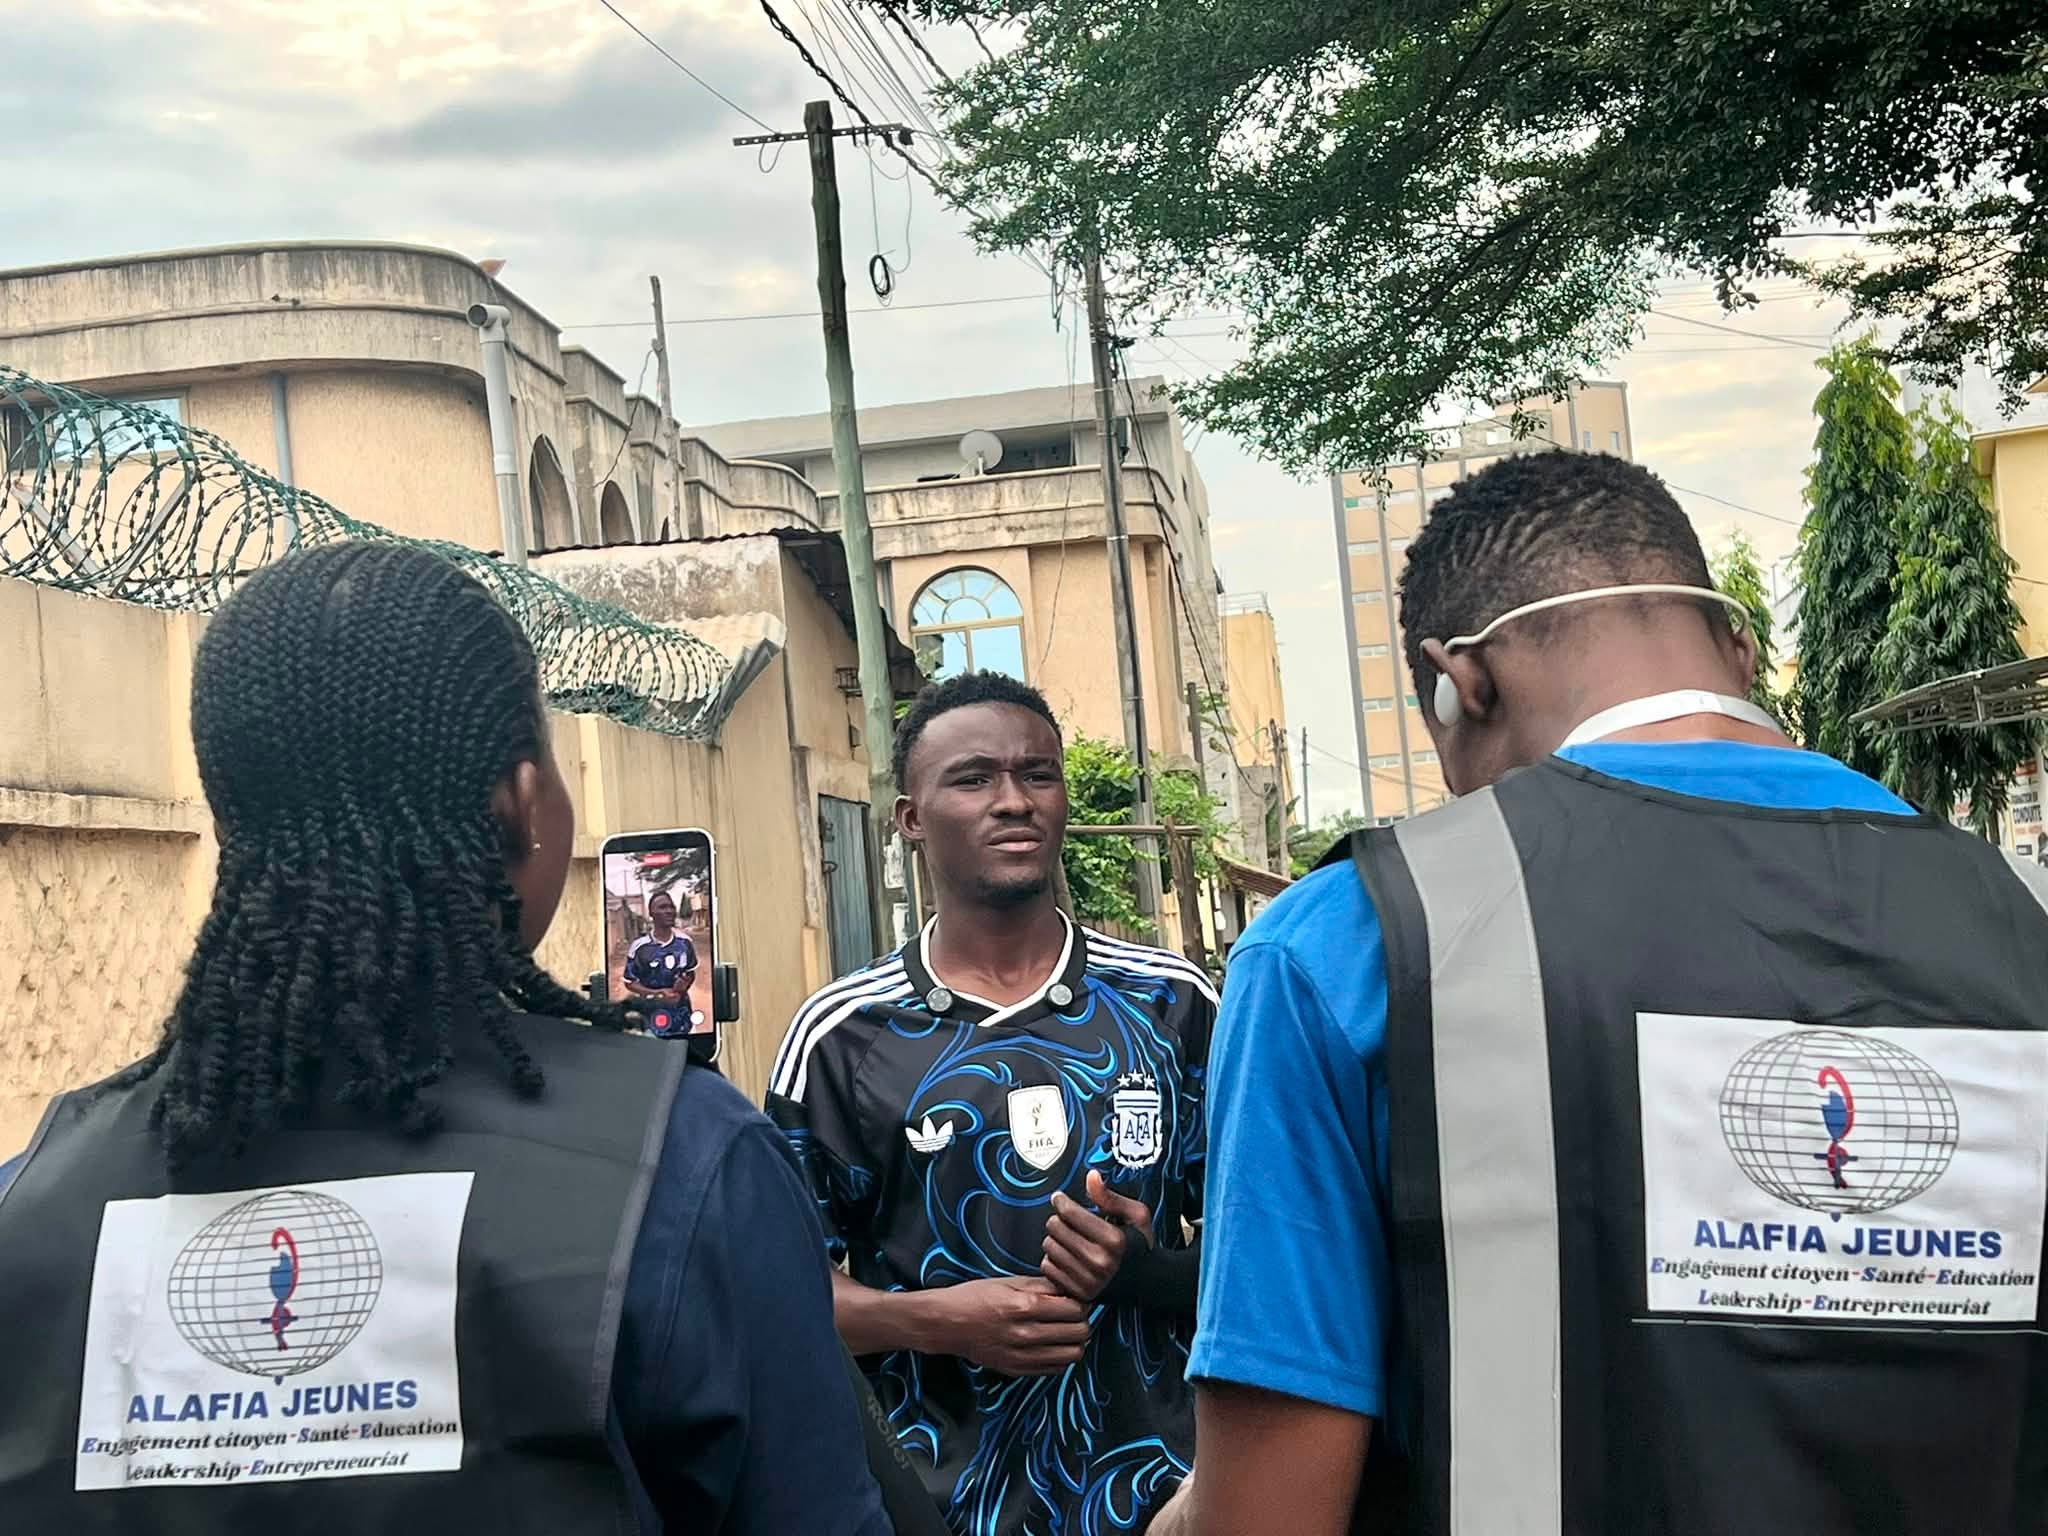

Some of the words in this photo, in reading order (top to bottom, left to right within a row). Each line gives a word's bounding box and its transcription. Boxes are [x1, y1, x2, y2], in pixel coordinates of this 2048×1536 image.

[1029, 1137, 1054, 1148] FIFA
[1124, 1111, 1151, 1146] AFA
[1694, 1219, 1826, 1253] ALAFIA
[1842, 1227, 2002, 1258] JEUNES
[1650, 1256, 1769, 1280] Engagement
[127, 1391, 269, 1423] ALAFIA
[282, 1380, 418, 1416] JEUNES
